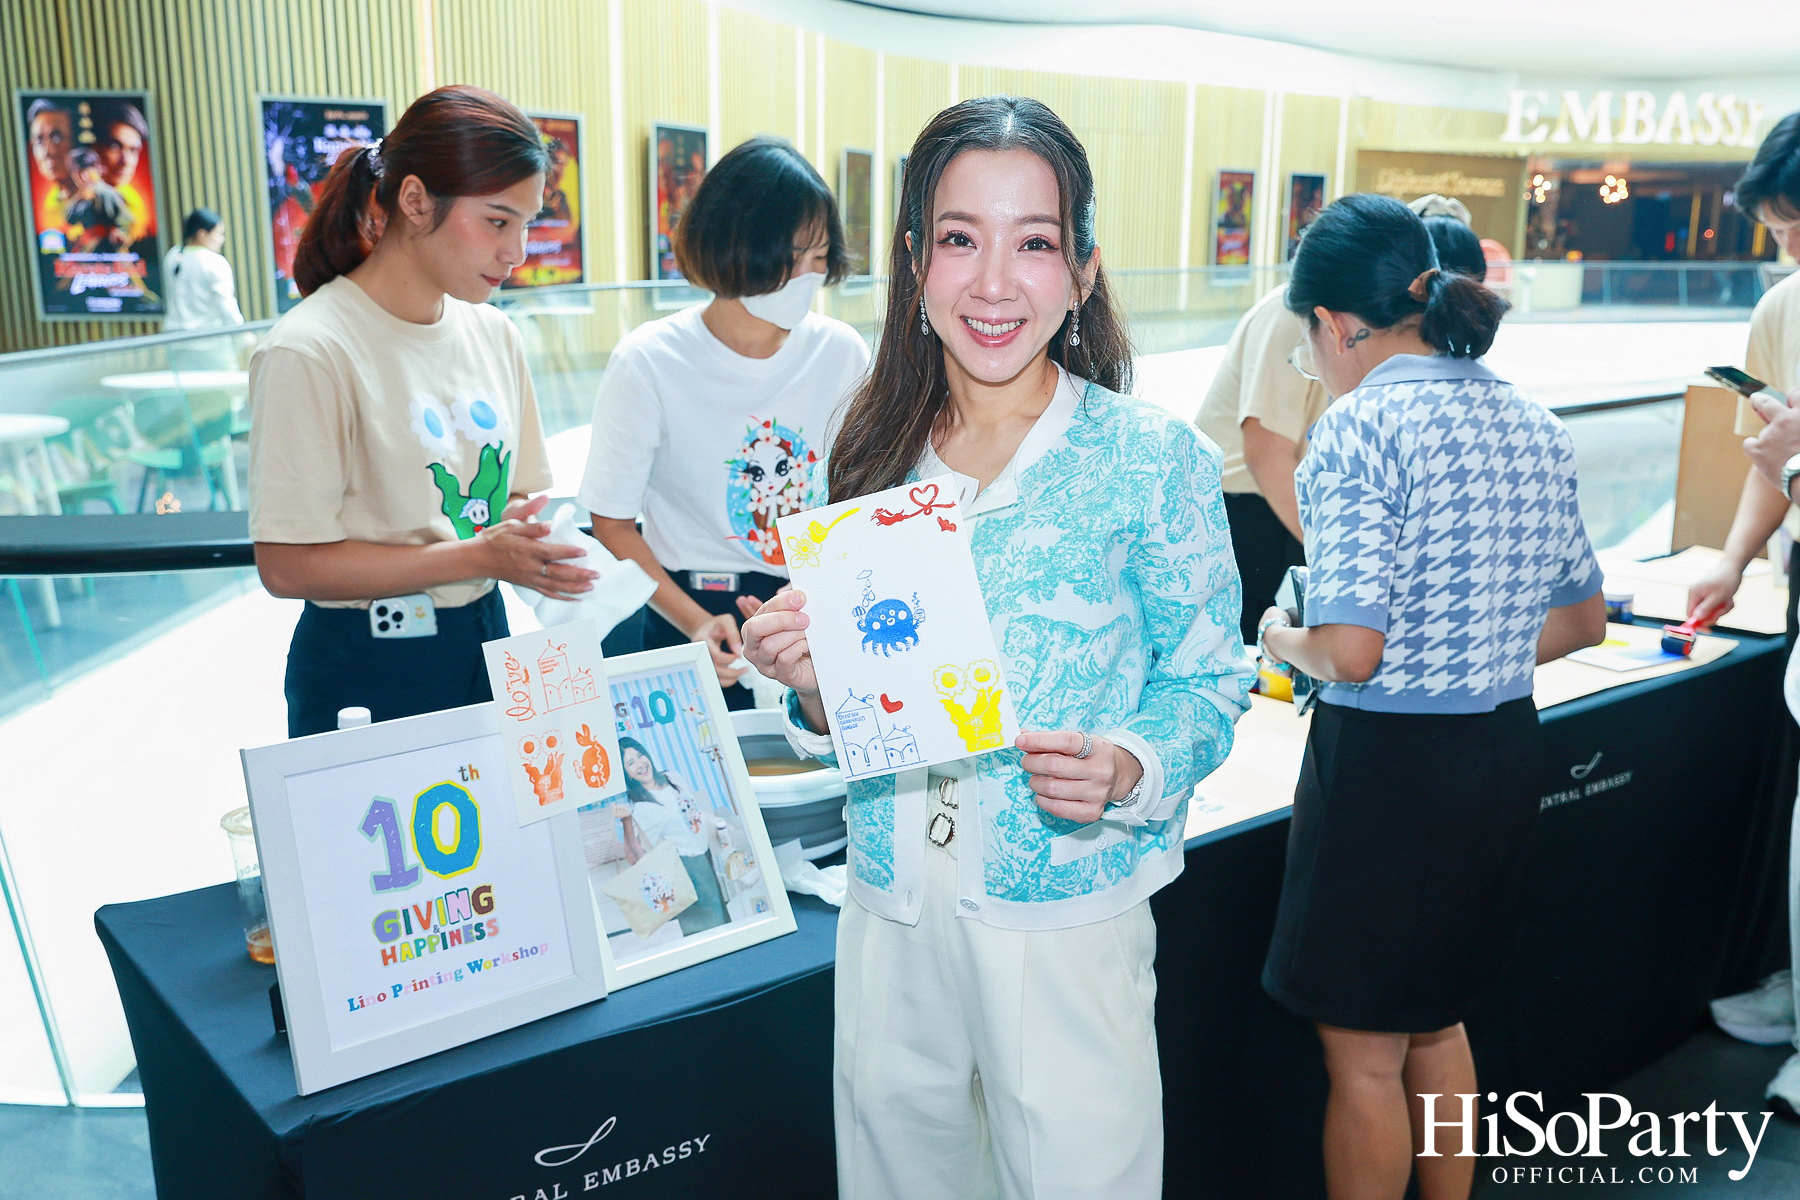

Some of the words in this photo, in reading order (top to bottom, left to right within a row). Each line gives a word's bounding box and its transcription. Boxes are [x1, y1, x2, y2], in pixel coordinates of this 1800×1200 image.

[1500, 89, 1764, 148] EMBASSY
[371, 884, 496, 944] GIVING
[380, 918, 501, 967] HAPPINESS
[433, 923, 441, 934] &
[347, 990, 387, 1012] Lino
[391, 966, 464, 999] Printing
[467, 941, 549, 975] Workshop
[583, 1134, 711, 1192] EMBASSY
